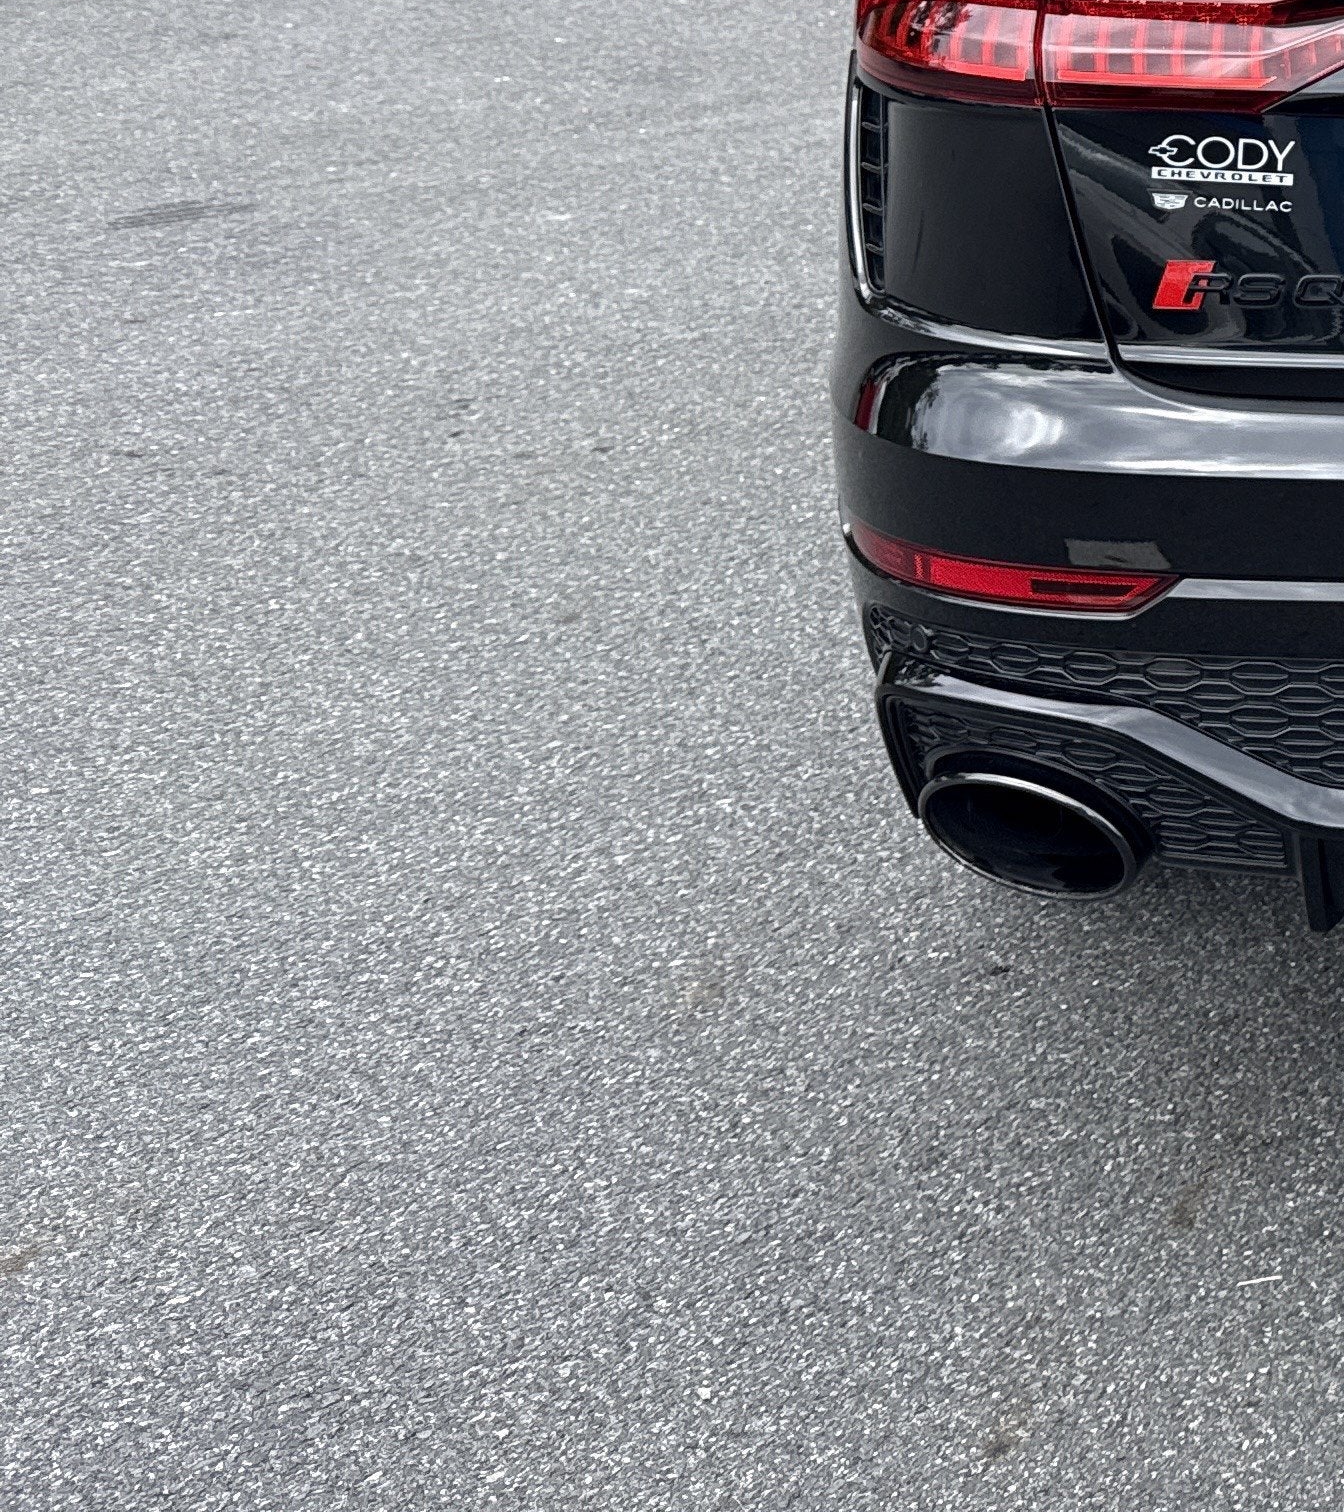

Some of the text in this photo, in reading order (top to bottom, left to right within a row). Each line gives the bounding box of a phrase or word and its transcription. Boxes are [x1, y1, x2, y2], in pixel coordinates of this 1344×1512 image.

[1155, 134, 1296, 171] CODY
[1156, 168, 1288, 185] CHEVROLET
[1193, 195, 1294, 213] CADILLAC
